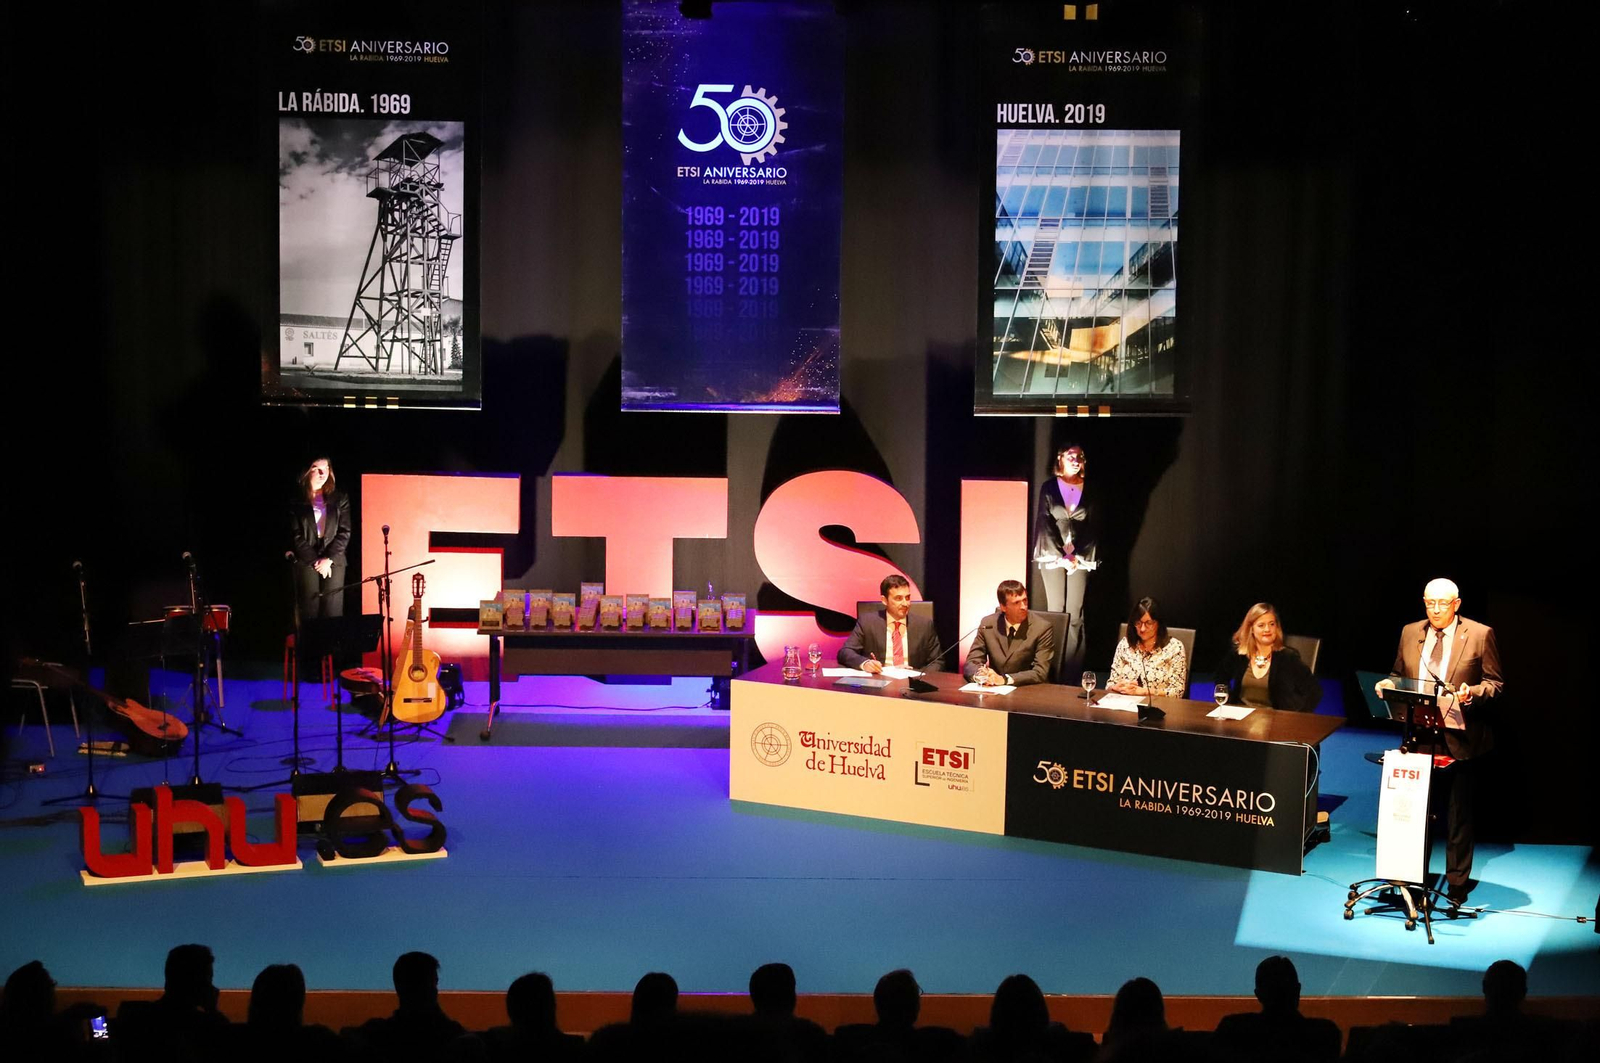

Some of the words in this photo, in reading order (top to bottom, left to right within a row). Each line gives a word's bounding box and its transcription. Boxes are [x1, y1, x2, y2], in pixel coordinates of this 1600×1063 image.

[319, 39, 346, 53] ETSI
[350, 40, 449, 55] ANIVERSARIO
[1038, 50, 1065, 63] ETSI
[1069, 51, 1167, 64] ANIVERSARIO
[386, 55, 422, 63] 1969-2019
[278, 91, 298, 111] LA
[302, 88, 365, 113] RÁBIDA.
[370, 93, 411, 114] 1969
[677, 83, 776, 154] 50
[996, 103, 1059, 124] HUELVA.
[1064, 103, 1105, 124] 2019
[677, 166, 701, 178] ETSI
[703, 167, 788, 179] ANIVERSARIO
[685, 206, 724, 226] 1969
[739, 206, 780, 226] 2019
[685, 229, 724, 249] 1969
[739, 230, 779, 249] 2019
[685, 252, 724, 272] 1969
[739, 253, 779, 273] 2019
[685, 276, 723, 295] 1969
[739, 276, 779, 296] 2019
[302, 329, 339, 340] SALTÉS
[361, 470, 1029, 683] ETSI
[798, 730, 892, 758] Universidad
[805, 751, 826, 772] de
[828, 754, 886, 781] Huelva
[922, 747, 969, 770] ETSI
[1392, 768, 1420, 780] ETSI
[1033, 760, 1066, 788] 50
[1073, 769, 1113, 793] ETSI
[1120, 775, 1276, 813] ANIVERSARIO
[1119, 798, 1132, 809] LA
[1134, 801, 1172, 814] RABIDA
[1176, 804, 1232, 822] 1969-2019
[1235, 812, 1275, 827] HUELVA
